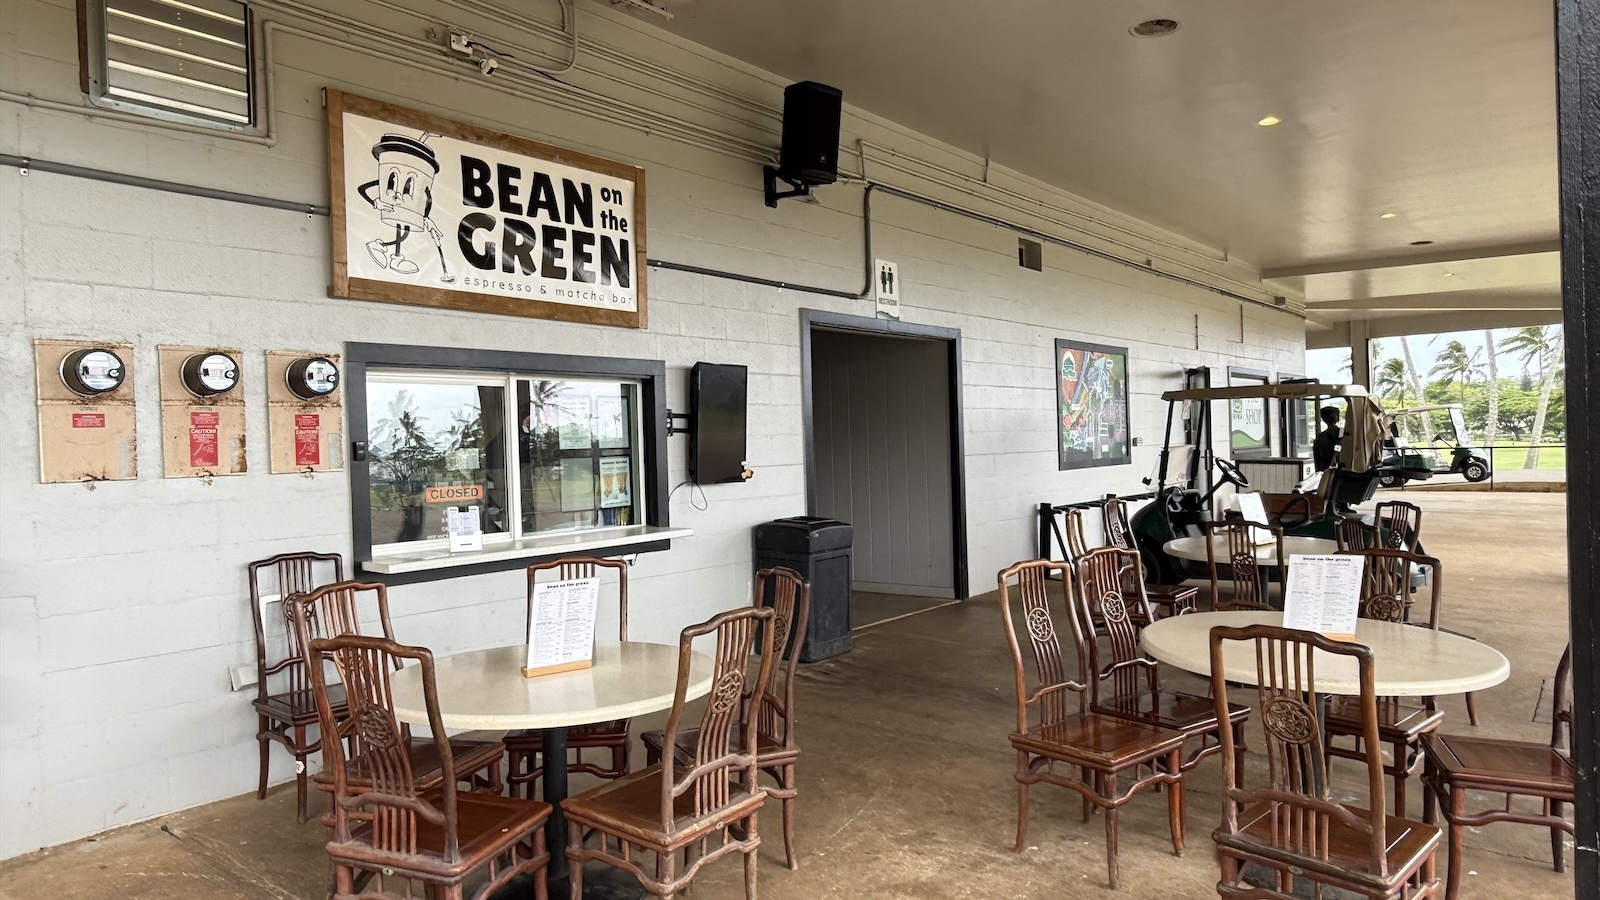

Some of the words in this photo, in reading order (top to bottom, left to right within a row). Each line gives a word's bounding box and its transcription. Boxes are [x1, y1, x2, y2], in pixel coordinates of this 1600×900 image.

[460, 155, 594, 228] BEAN
[600, 186, 623, 206] on
[600, 209, 628, 233] the
[457, 212, 631, 289] GREEN
[464, 276, 532, 293] espresso
[539, 285, 548, 295] &
[555, 288, 605, 302] matcha
[612, 293, 633, 305] bar
[1245, 408, 1262, 425] SHOP
[430, 487, 479, 499] CLOSED
